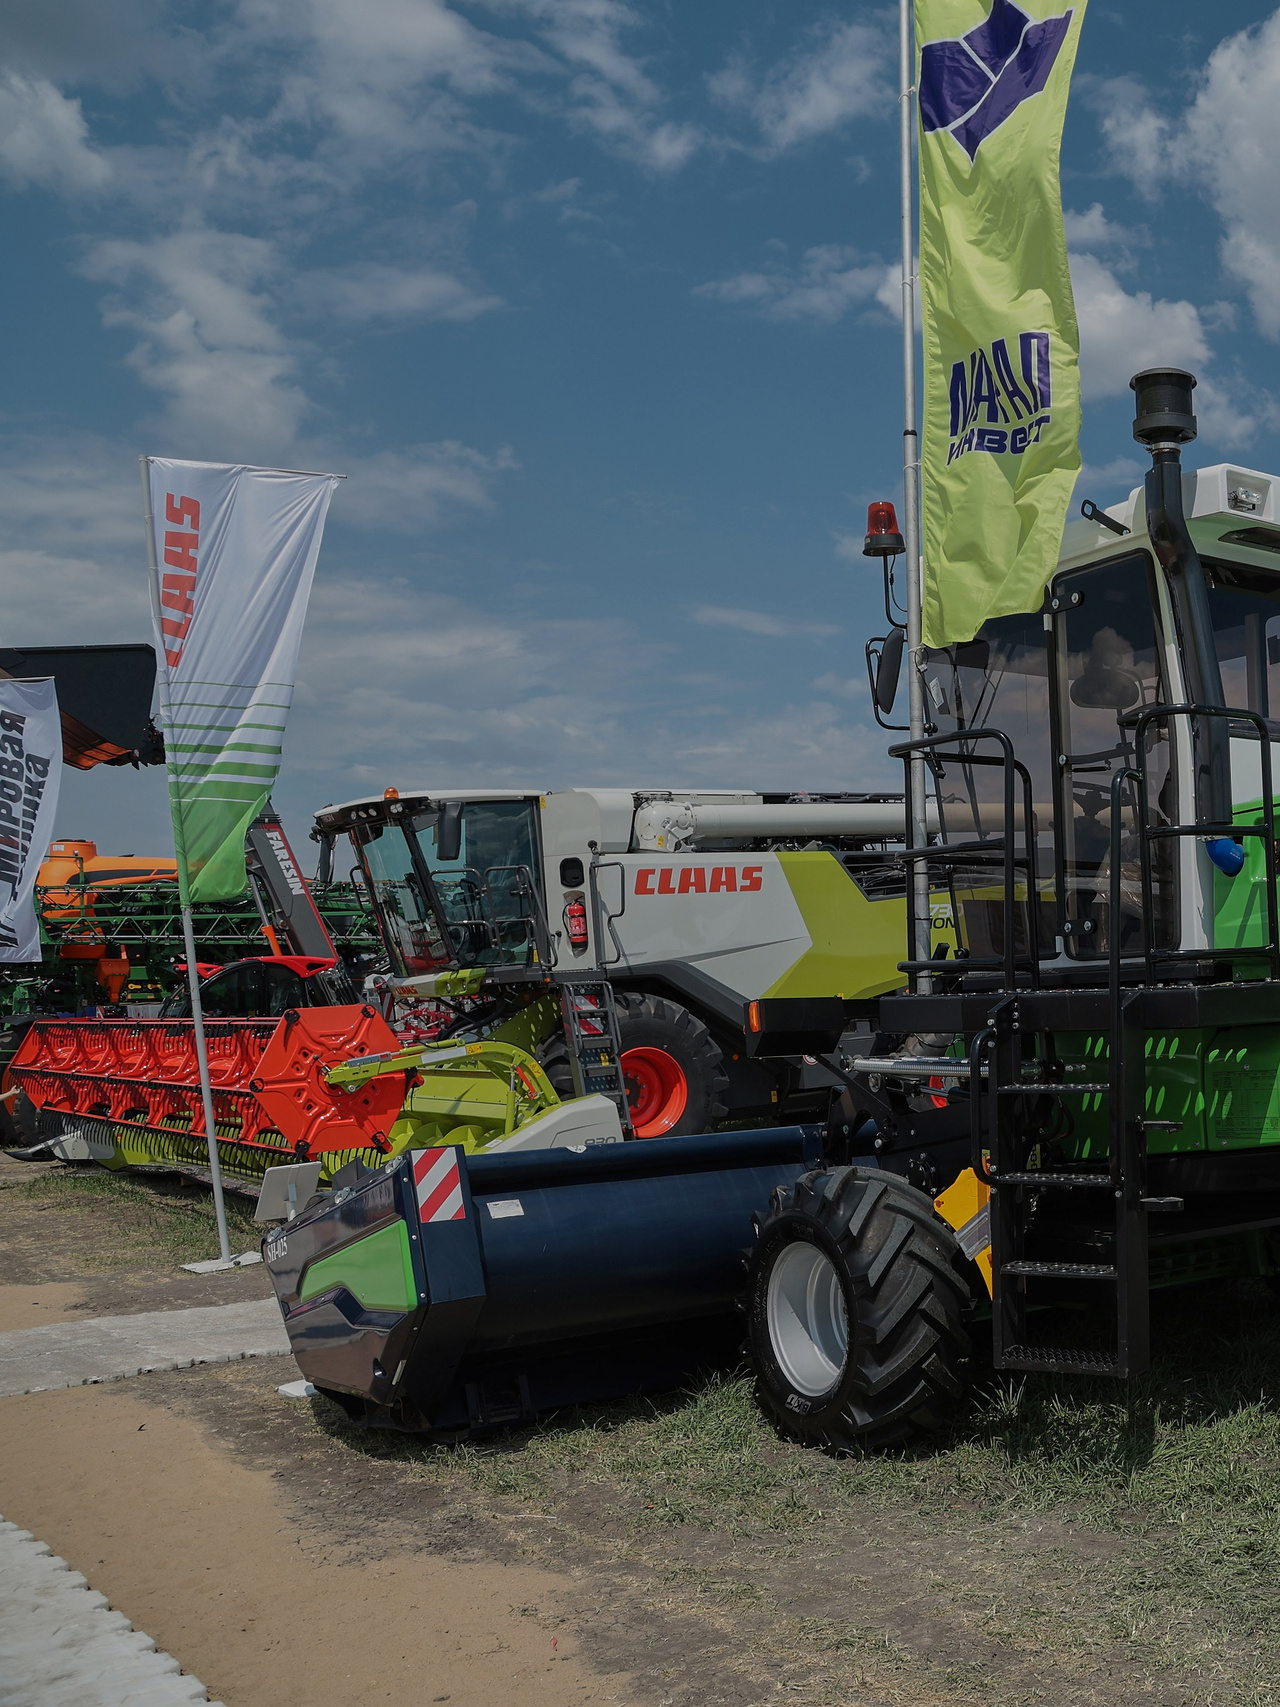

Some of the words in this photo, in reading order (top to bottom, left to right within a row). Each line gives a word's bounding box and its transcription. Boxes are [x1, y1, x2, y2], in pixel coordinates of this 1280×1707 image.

[266, 831, 305, 895] FARESIN
[634, 866, 763, 896] CLAAS
[785, 1394, 811, 1415] BKT
